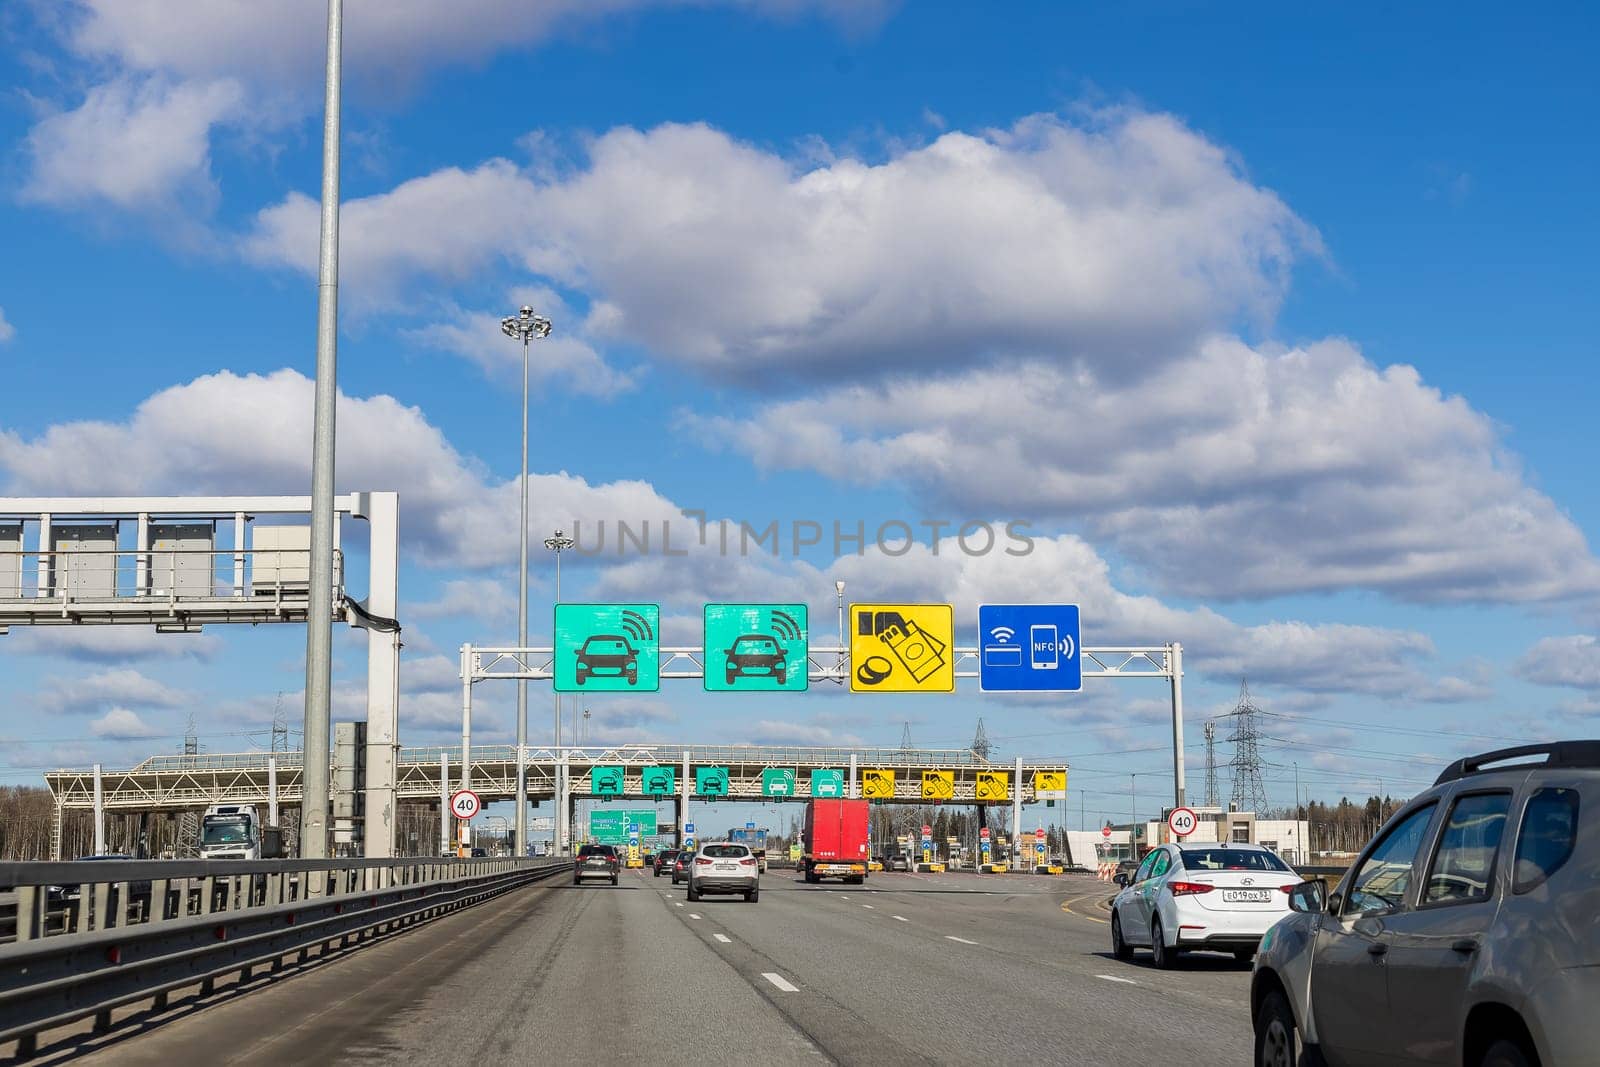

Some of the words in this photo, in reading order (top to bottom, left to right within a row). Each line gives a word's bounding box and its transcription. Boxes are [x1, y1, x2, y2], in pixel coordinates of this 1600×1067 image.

[1034, 642, 1054, 652] NFC
[457, 799, 474, 811] 40
[1175, 816, 1191, 828] 40
